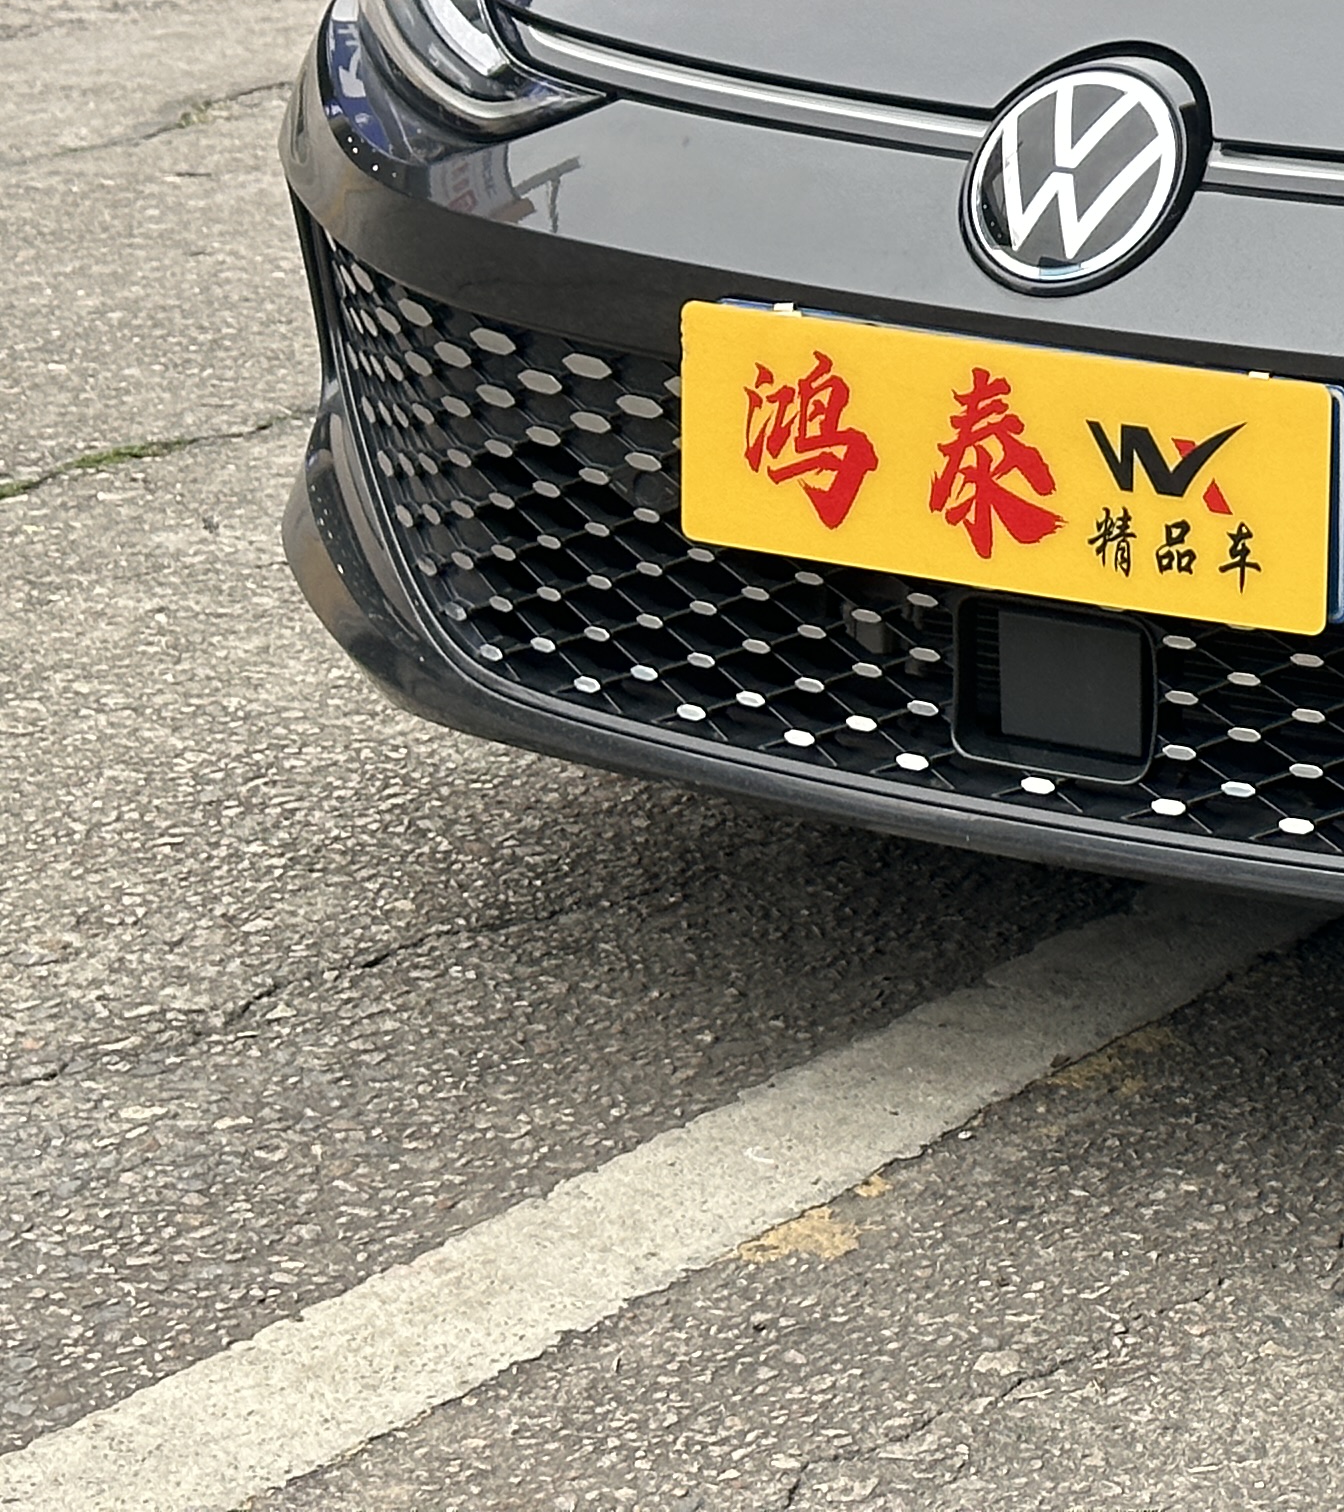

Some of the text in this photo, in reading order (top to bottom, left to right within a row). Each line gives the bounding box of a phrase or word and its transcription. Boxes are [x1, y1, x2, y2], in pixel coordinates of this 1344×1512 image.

[742, 350, 1069, 561] 鸿泰
[1087, 506, 1263, 594] 精品车
